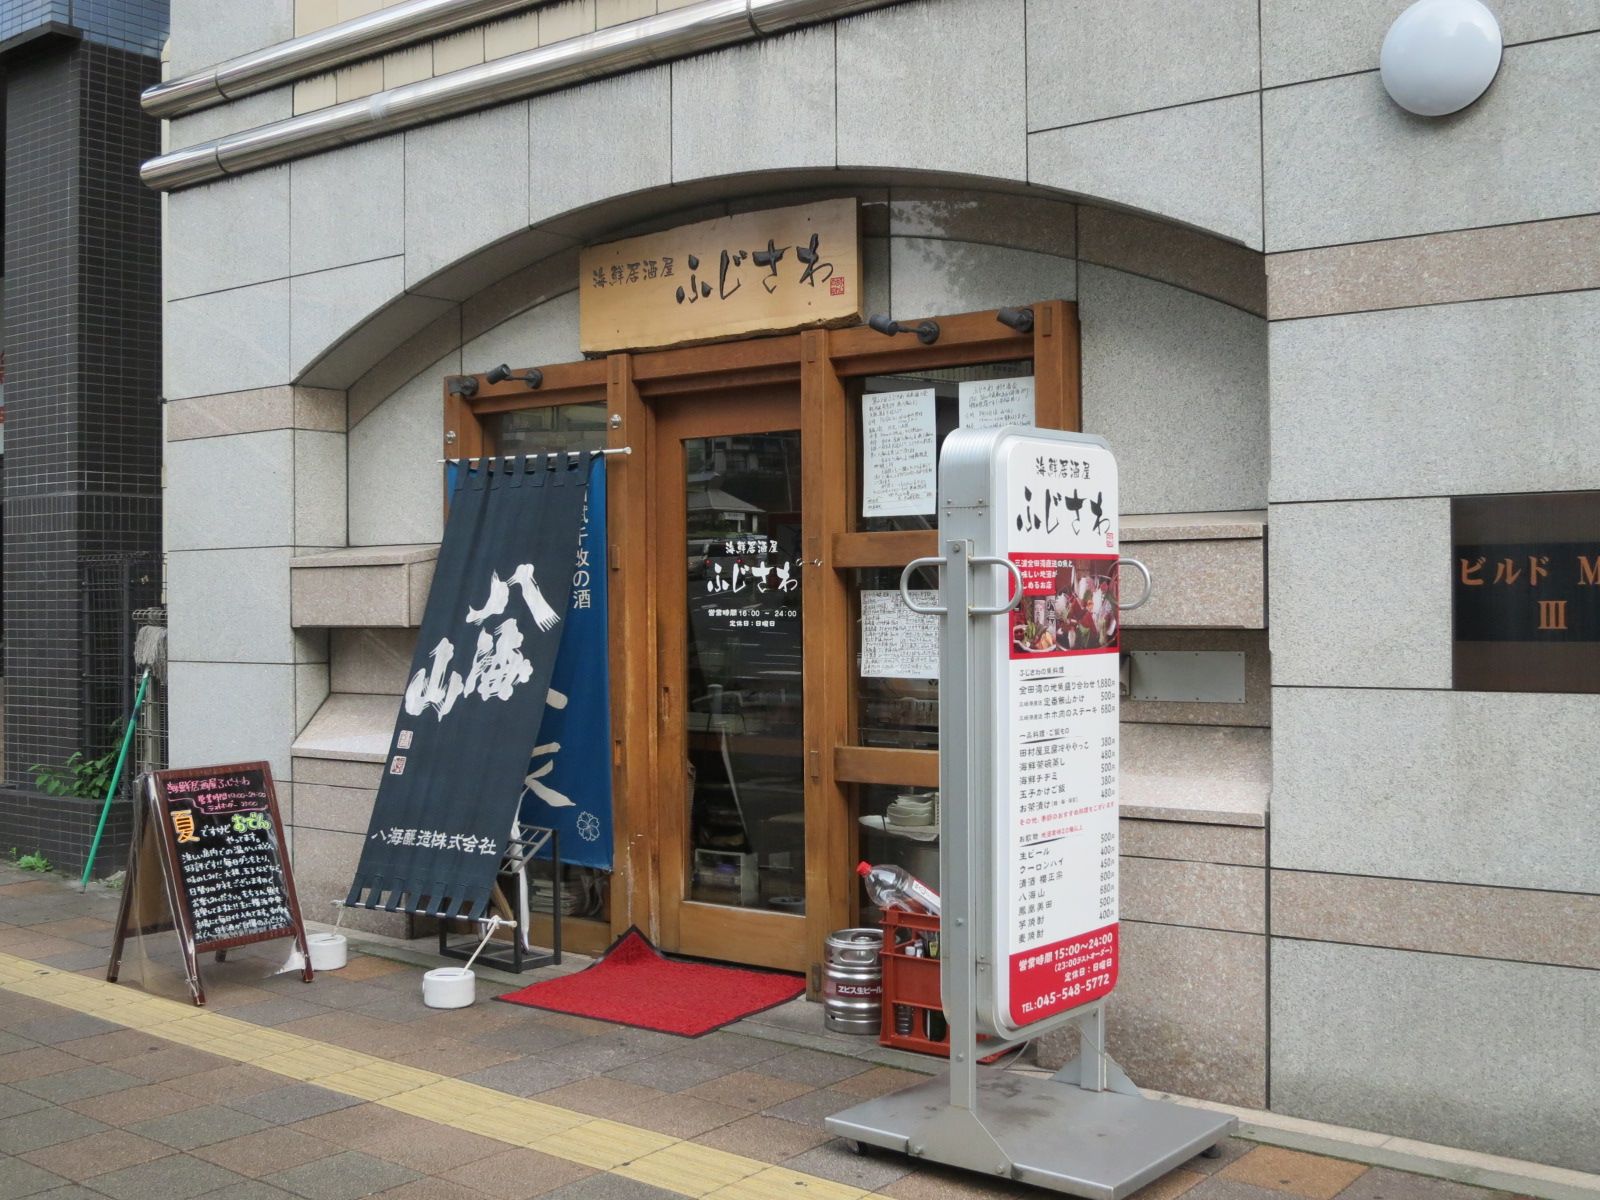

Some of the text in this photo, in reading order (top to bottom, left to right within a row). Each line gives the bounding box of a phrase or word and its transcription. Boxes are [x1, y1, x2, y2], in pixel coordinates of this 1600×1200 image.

[592, 256, 674, 288] 海鮮居酒屋
[676, 232, 834, 304] ふじさわ
[1035, 456, 1091, 480] 海鮮居酒屋
[1016, 486, 1111, 536] ふじさわ
[725, 540, 778, 554] 海鮮居酒屋
[707, 560, 798, 593] ふじさわ
[1020, 570, 1058, 578] 味しい地酒が
[1459, 555, 1550, 587] ビルド
[708, 608, 738, 617] 営業時間
[774, 610, 797, 618] 24:00
[404, 563, 561, 722] 八海山
[170, 809, 201, 844] 夏
[231, 812, 271, 832] おでん
[371, 827, 497, 856] 八海醸造株式会社
[1019, 848, 1050, 860] 生ビール
[1018, 888, 1046, 902] 八海山
[1018, 952, 1053, 972] 営業時間
